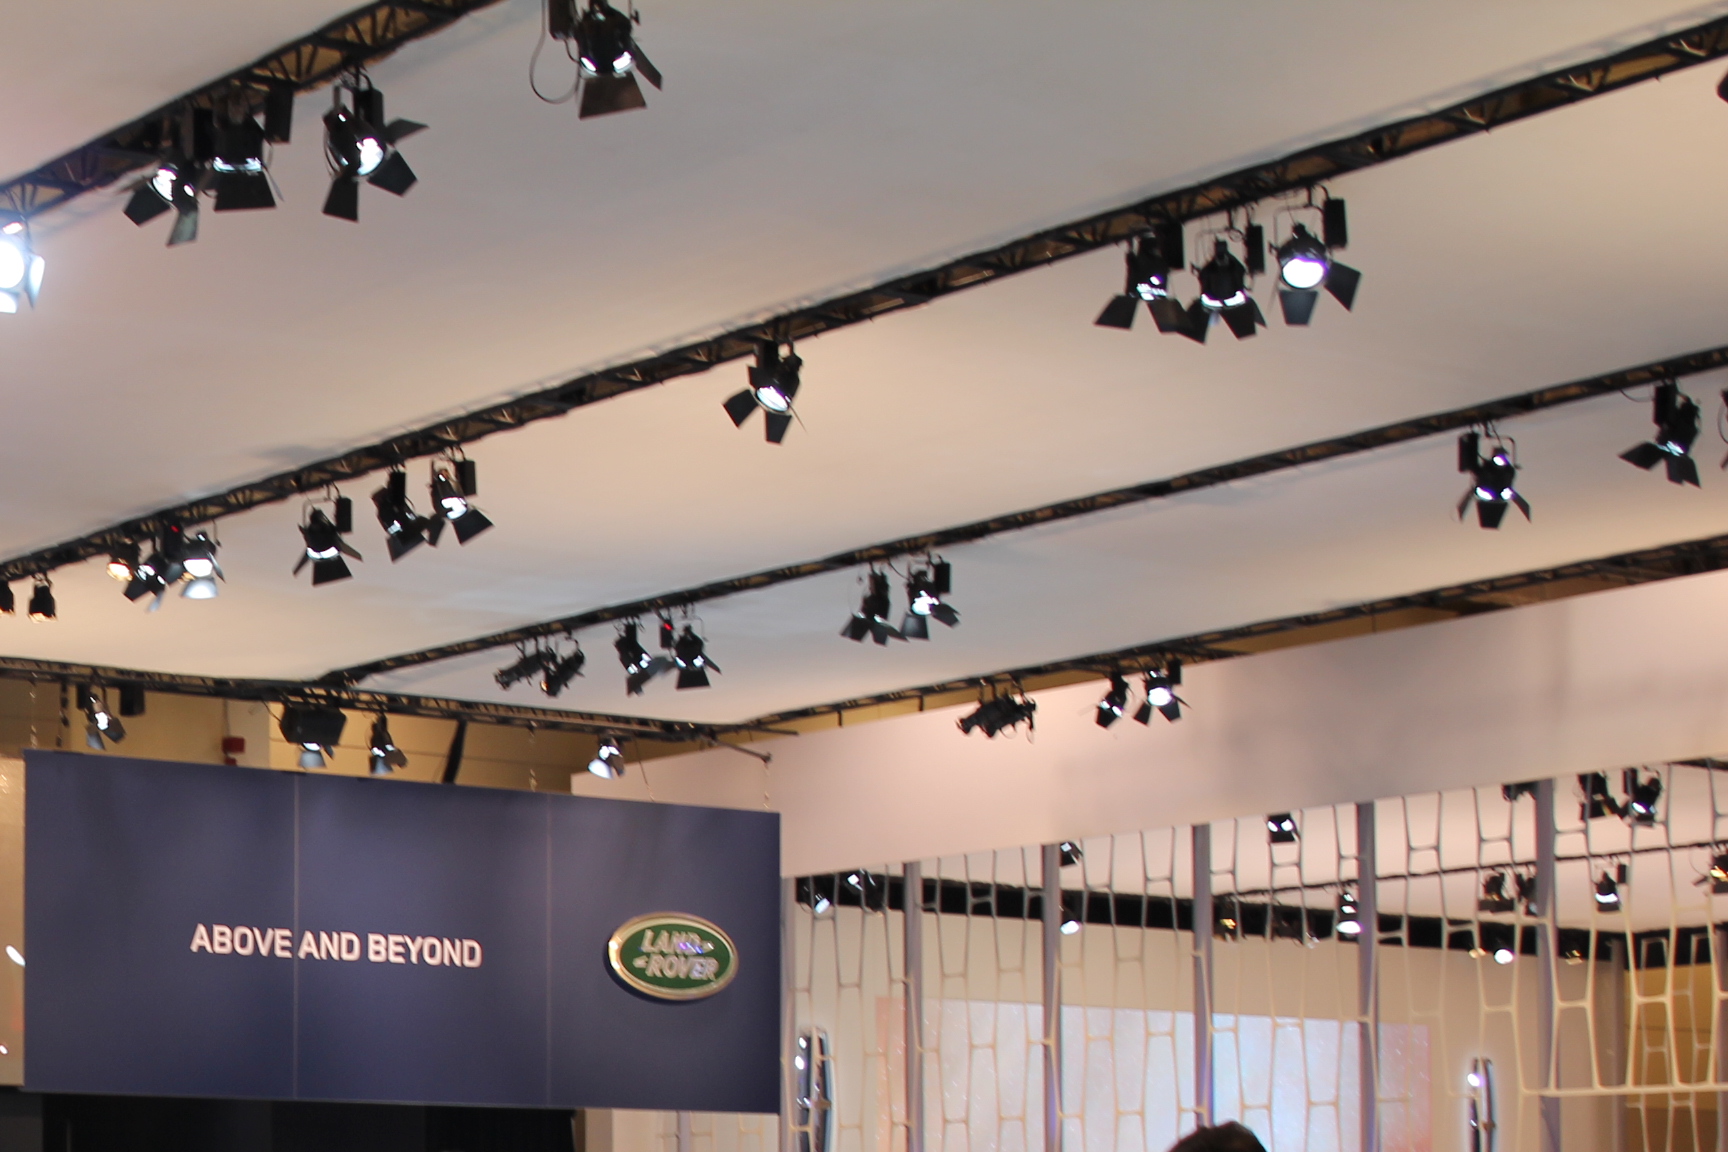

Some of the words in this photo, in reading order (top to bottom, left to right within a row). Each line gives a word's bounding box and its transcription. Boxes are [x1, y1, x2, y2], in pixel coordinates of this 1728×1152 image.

[189, 921, 293, 959] ABOVE
[297, 930, 362, 962] AND
[367, 932, 483, 969] BEYOND
[640, 928, 705, 956] LAND
[645, 953, 720, 982] ROVER
